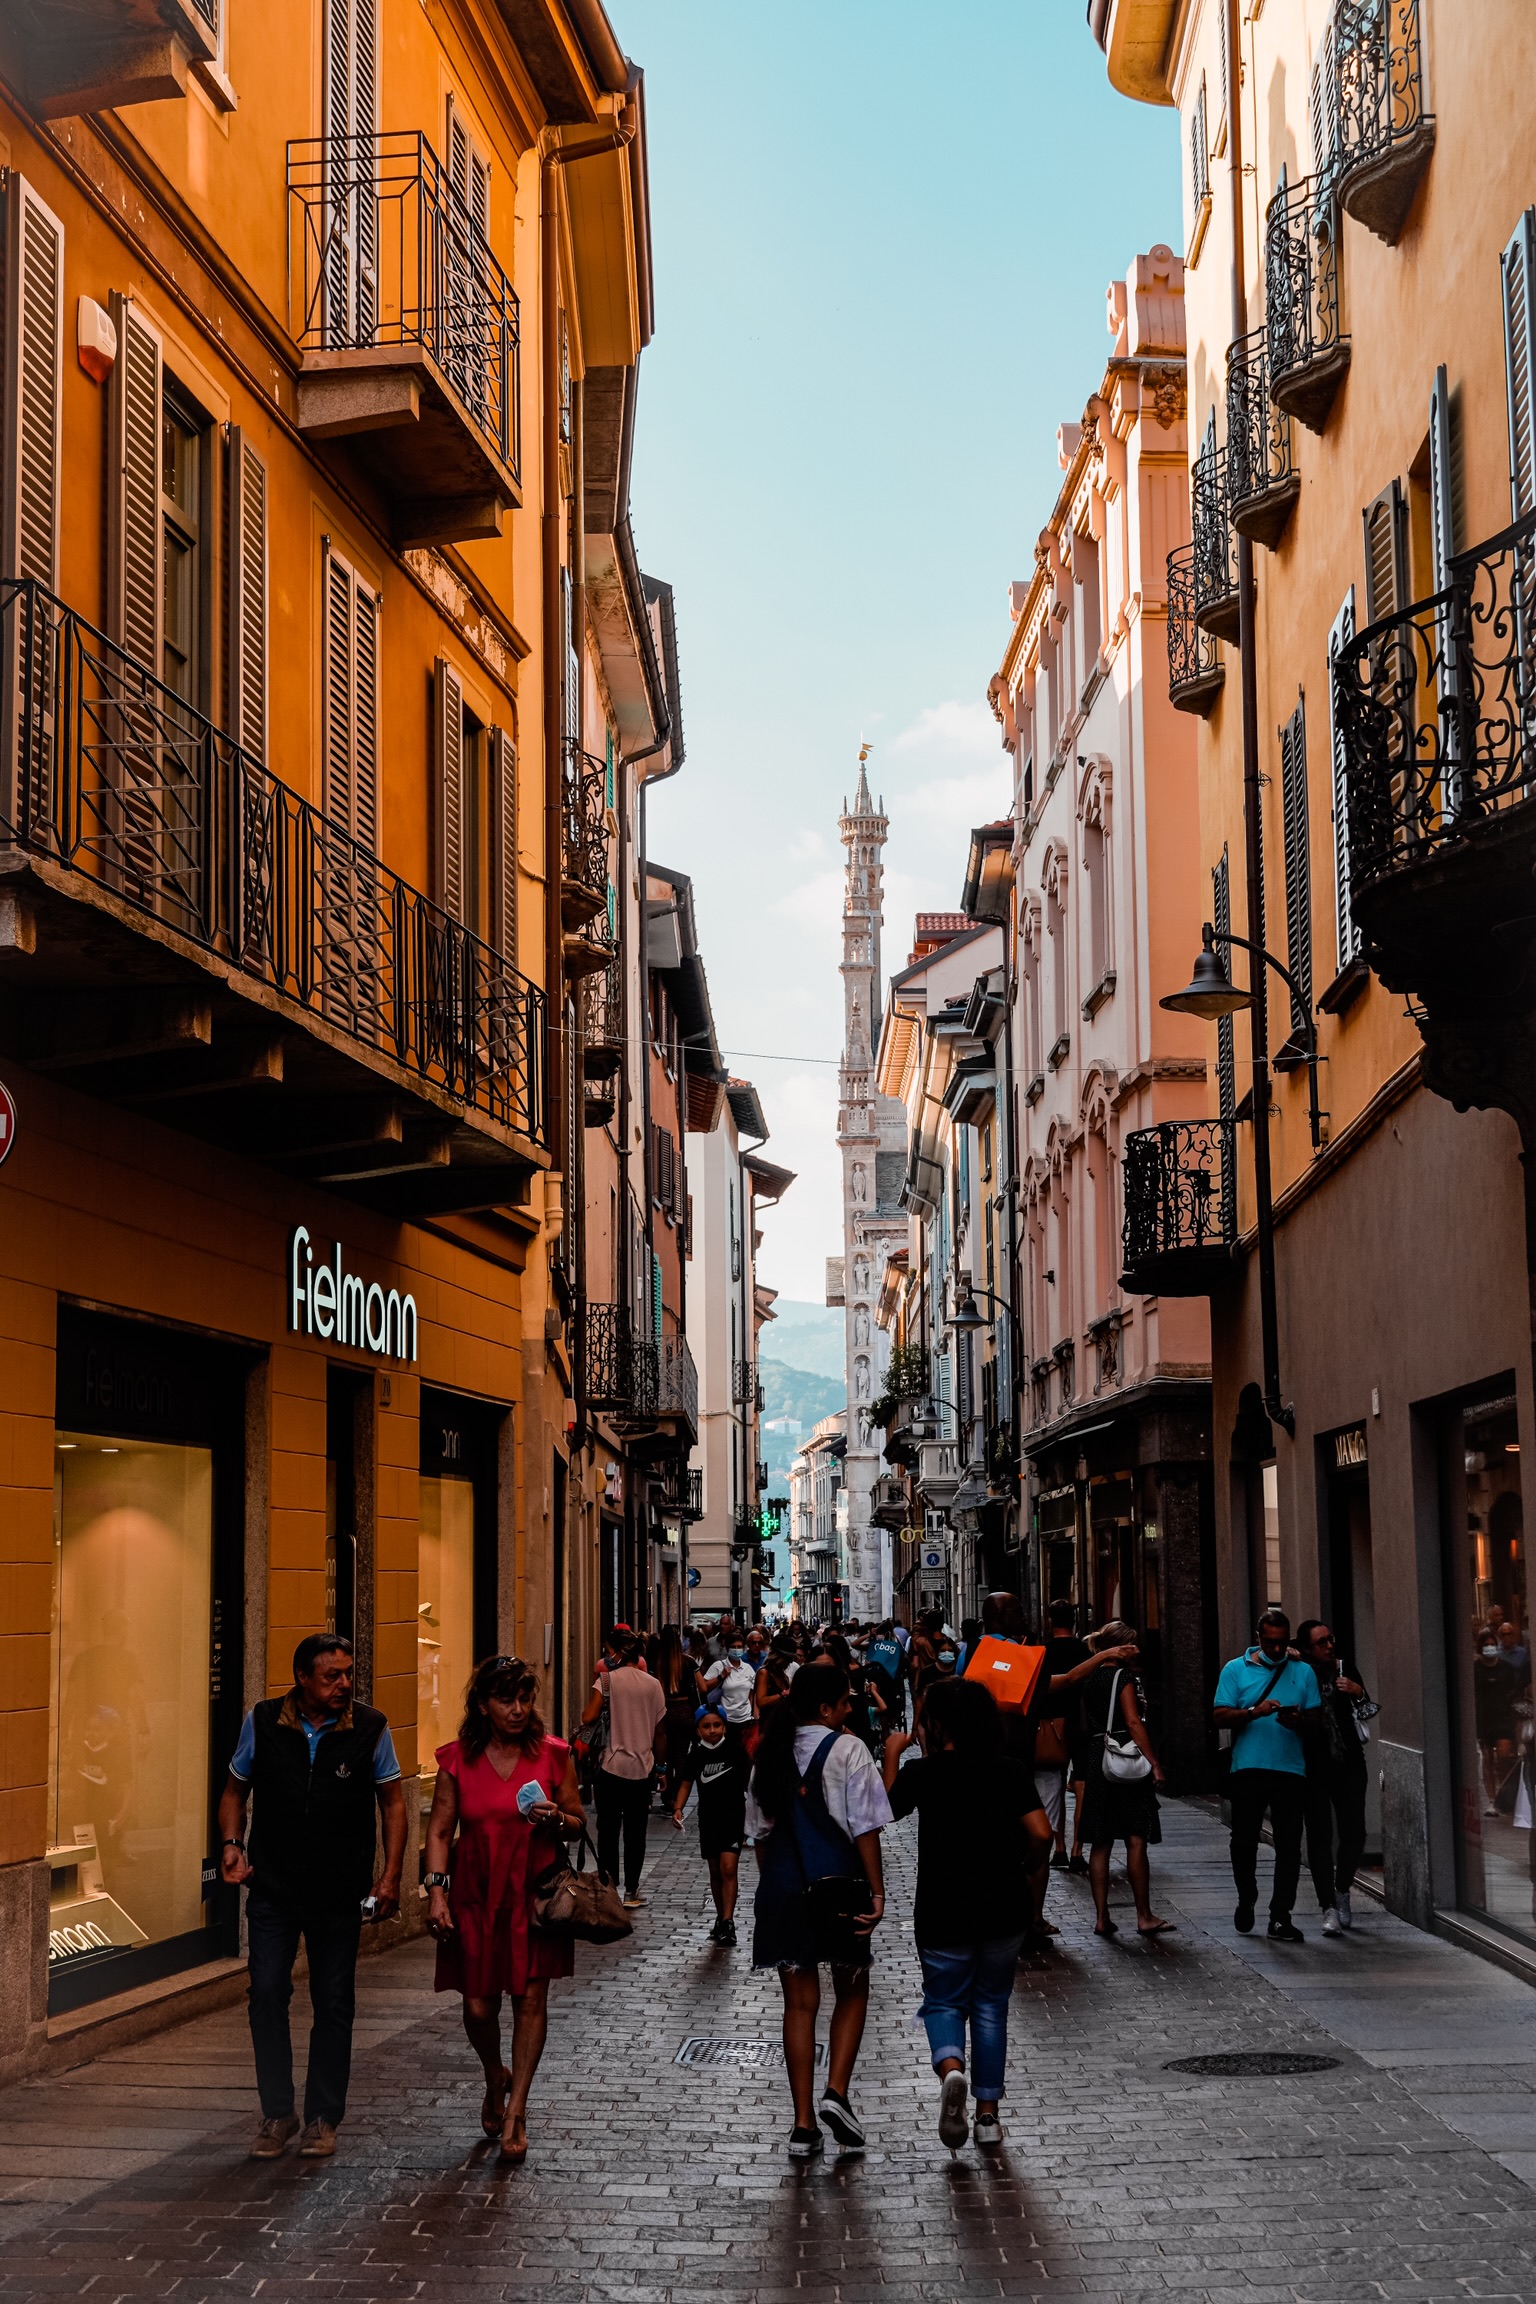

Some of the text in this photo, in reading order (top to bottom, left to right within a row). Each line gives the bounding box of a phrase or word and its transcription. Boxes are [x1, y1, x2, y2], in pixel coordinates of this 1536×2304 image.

[292, 1225, 418, 1362] fielmann
[703, 1762, 725, 1776] NIKE
[202, 1867, 217, 1883] ZEISS
